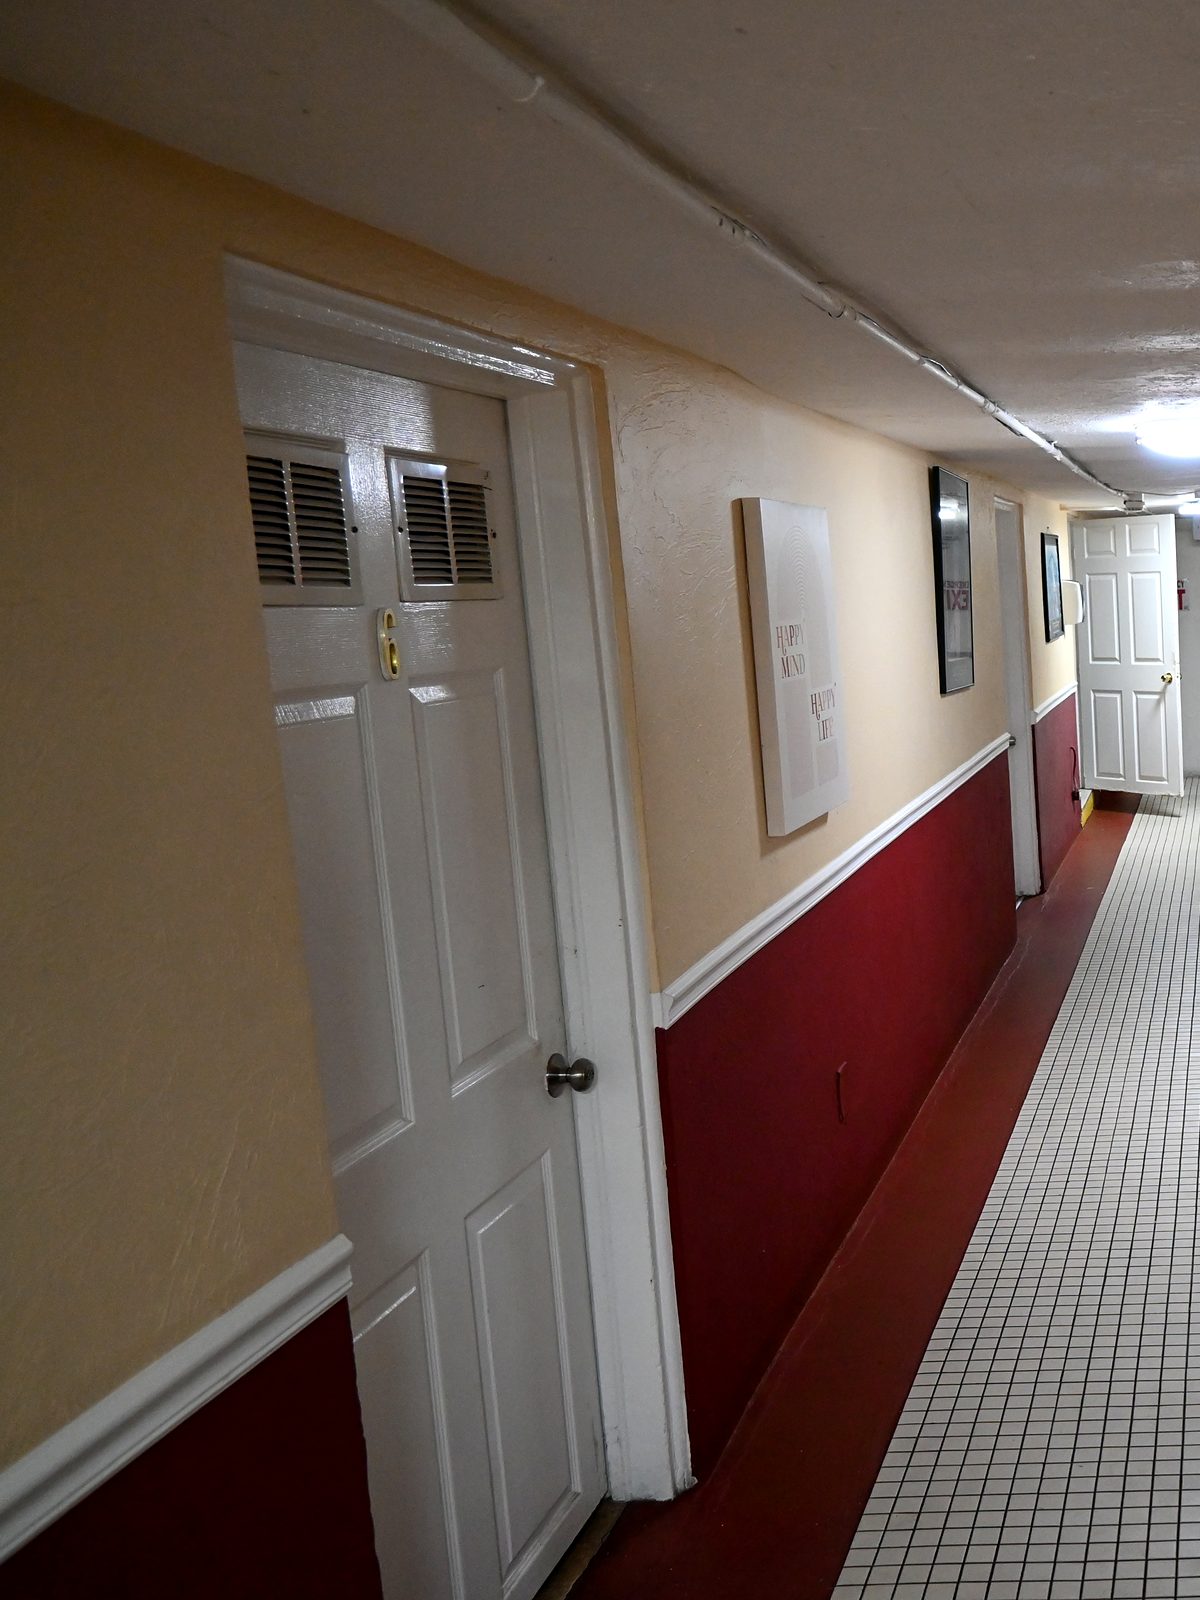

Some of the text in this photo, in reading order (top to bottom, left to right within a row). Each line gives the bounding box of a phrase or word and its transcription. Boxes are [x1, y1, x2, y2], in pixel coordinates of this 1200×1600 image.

[379, 608, 400, 680] 6
[776, 624, 804, 656] HAPPY
[781, 653, 806, 679] MIND
[811, 687, 836, 720] HAPPY
[817, 717, 834, 742] LIFE
